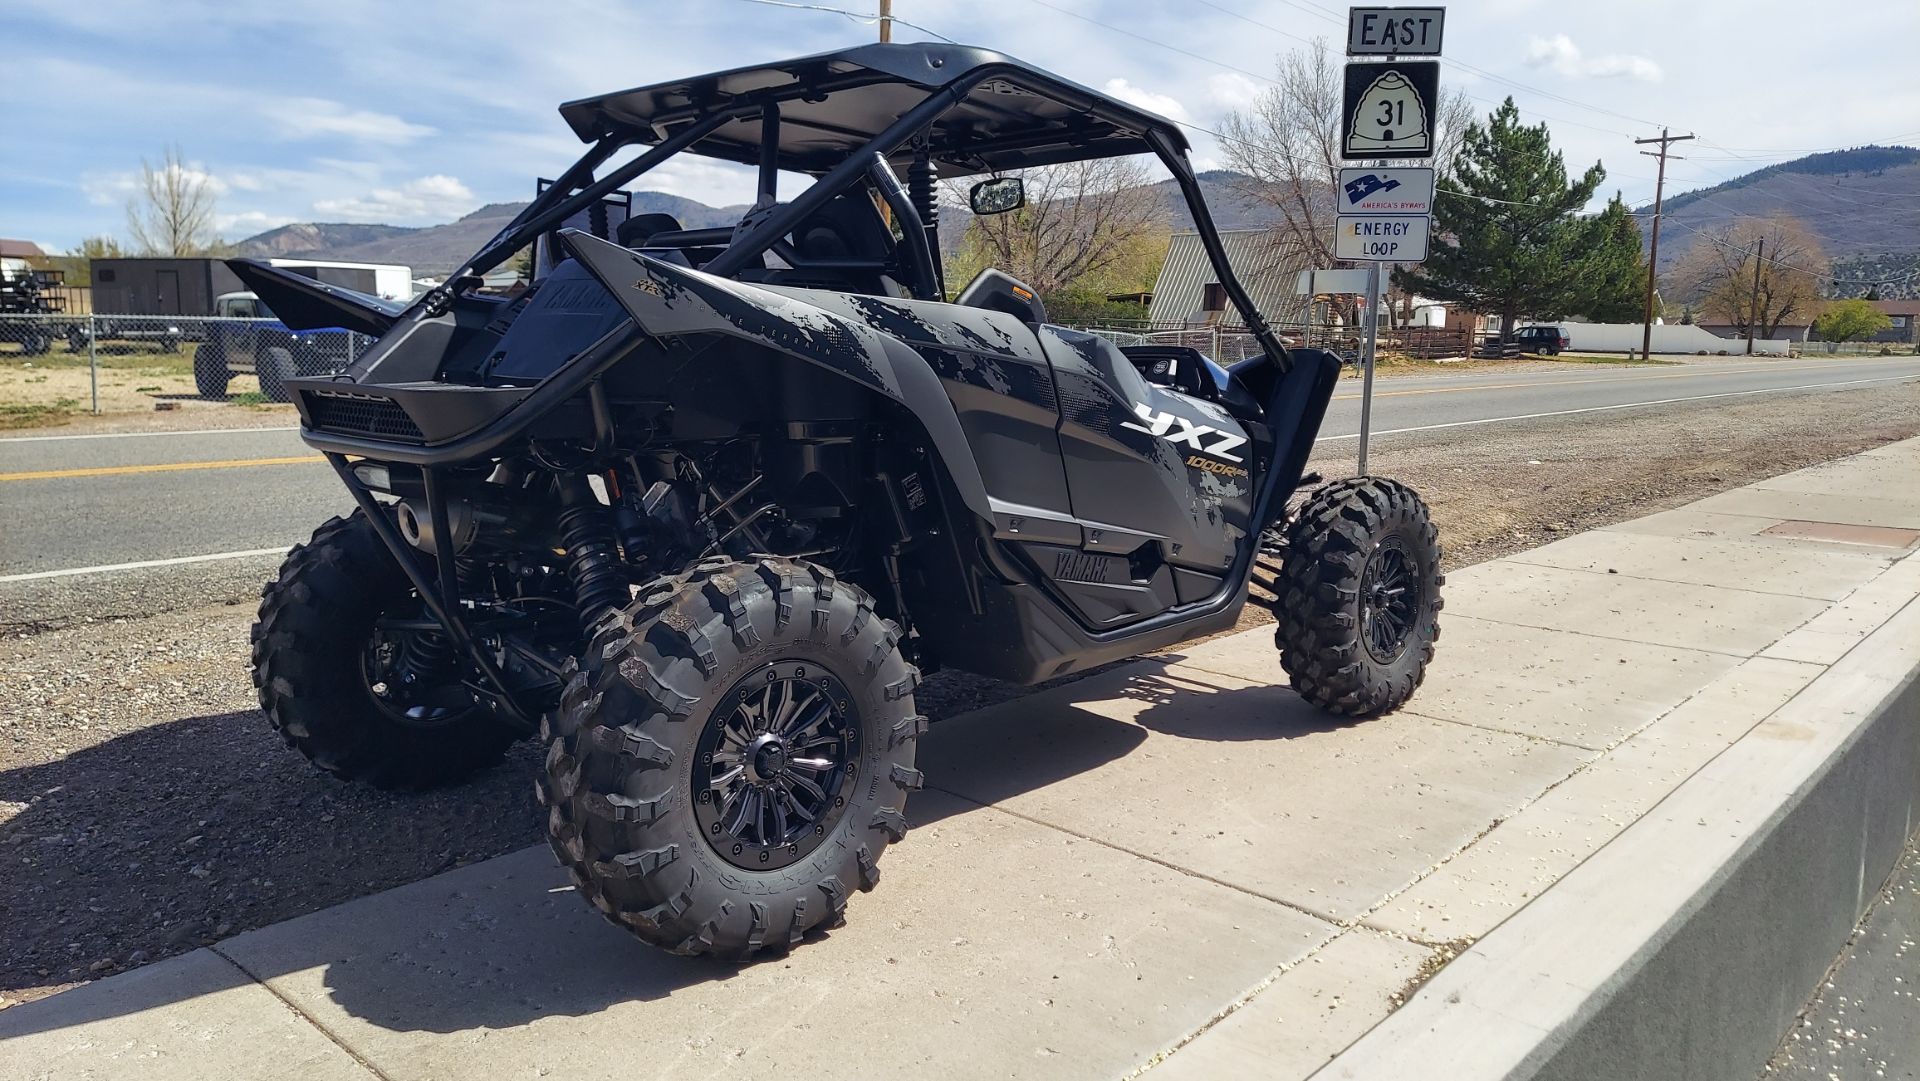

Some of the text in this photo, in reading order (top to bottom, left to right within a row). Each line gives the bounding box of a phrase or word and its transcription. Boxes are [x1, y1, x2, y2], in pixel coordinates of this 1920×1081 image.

[1361, 14, 1432, 46] EAST
[1376, 100, 1404, 127] 31
[1354, 222, 1410, 236] ENERGY
[1363, 242, 1398, 256] LOOP
[761, 325, 831, 355] TERRAIN
[1120, 401, 1248, 463] YXZ
[1054, 553, 1111, 582] YAMAHA
